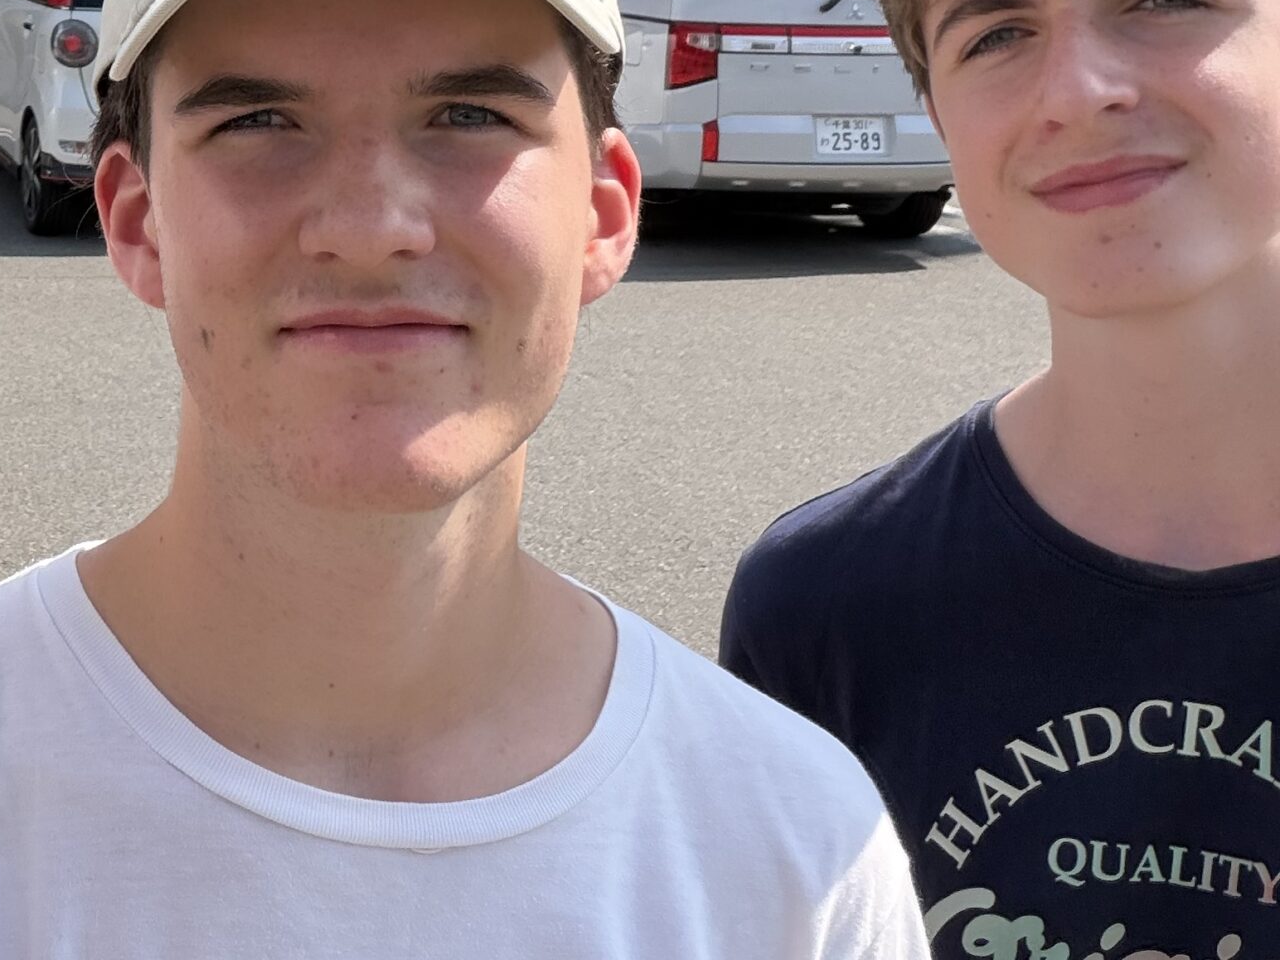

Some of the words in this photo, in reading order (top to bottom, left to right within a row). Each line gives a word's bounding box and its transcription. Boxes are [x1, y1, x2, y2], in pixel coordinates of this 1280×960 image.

[832, 132, 881, 151] 25-89
[925, 698, 1280, 870] HANDCRA
[1047, 837, 1280, 904] QUALITY
